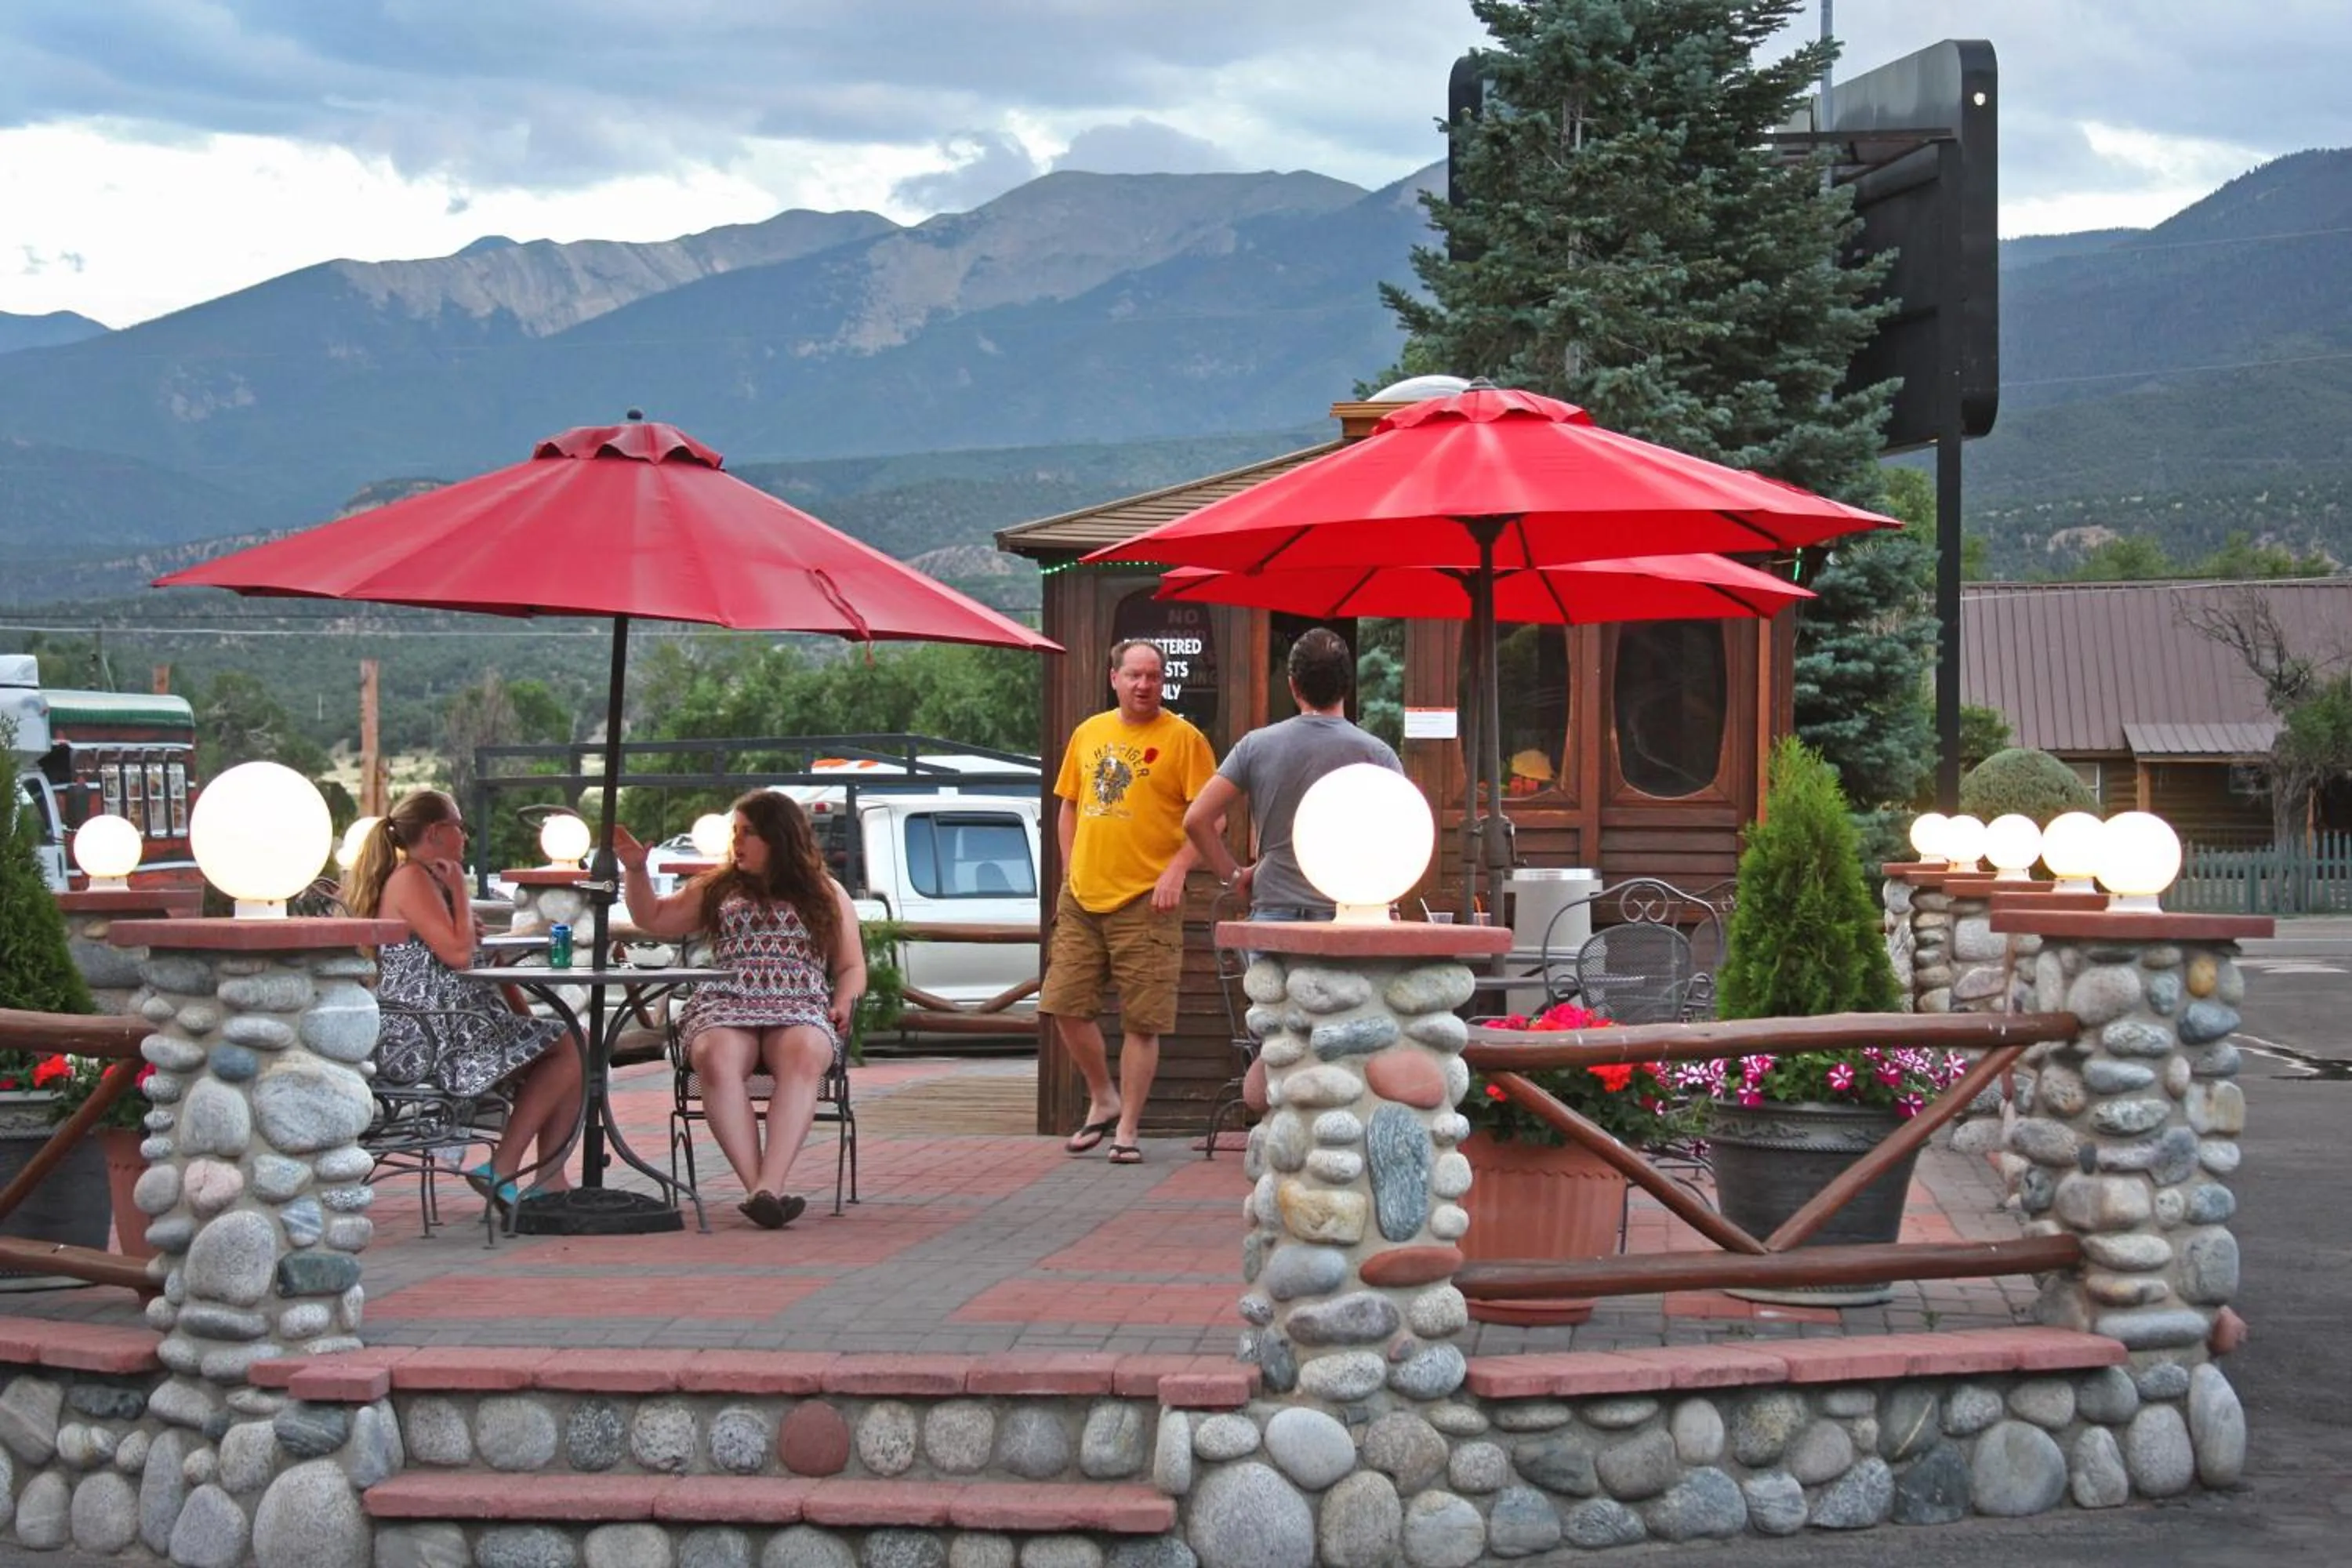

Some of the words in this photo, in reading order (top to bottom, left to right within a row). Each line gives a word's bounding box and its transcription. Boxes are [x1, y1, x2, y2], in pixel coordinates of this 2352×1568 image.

[1168, 608, 1199, 624] NO
[1124, 638, 1202, 655] STERED
[1164, 661, 1189, 677] STS
[1162, 684, 1181, 699] NLY
